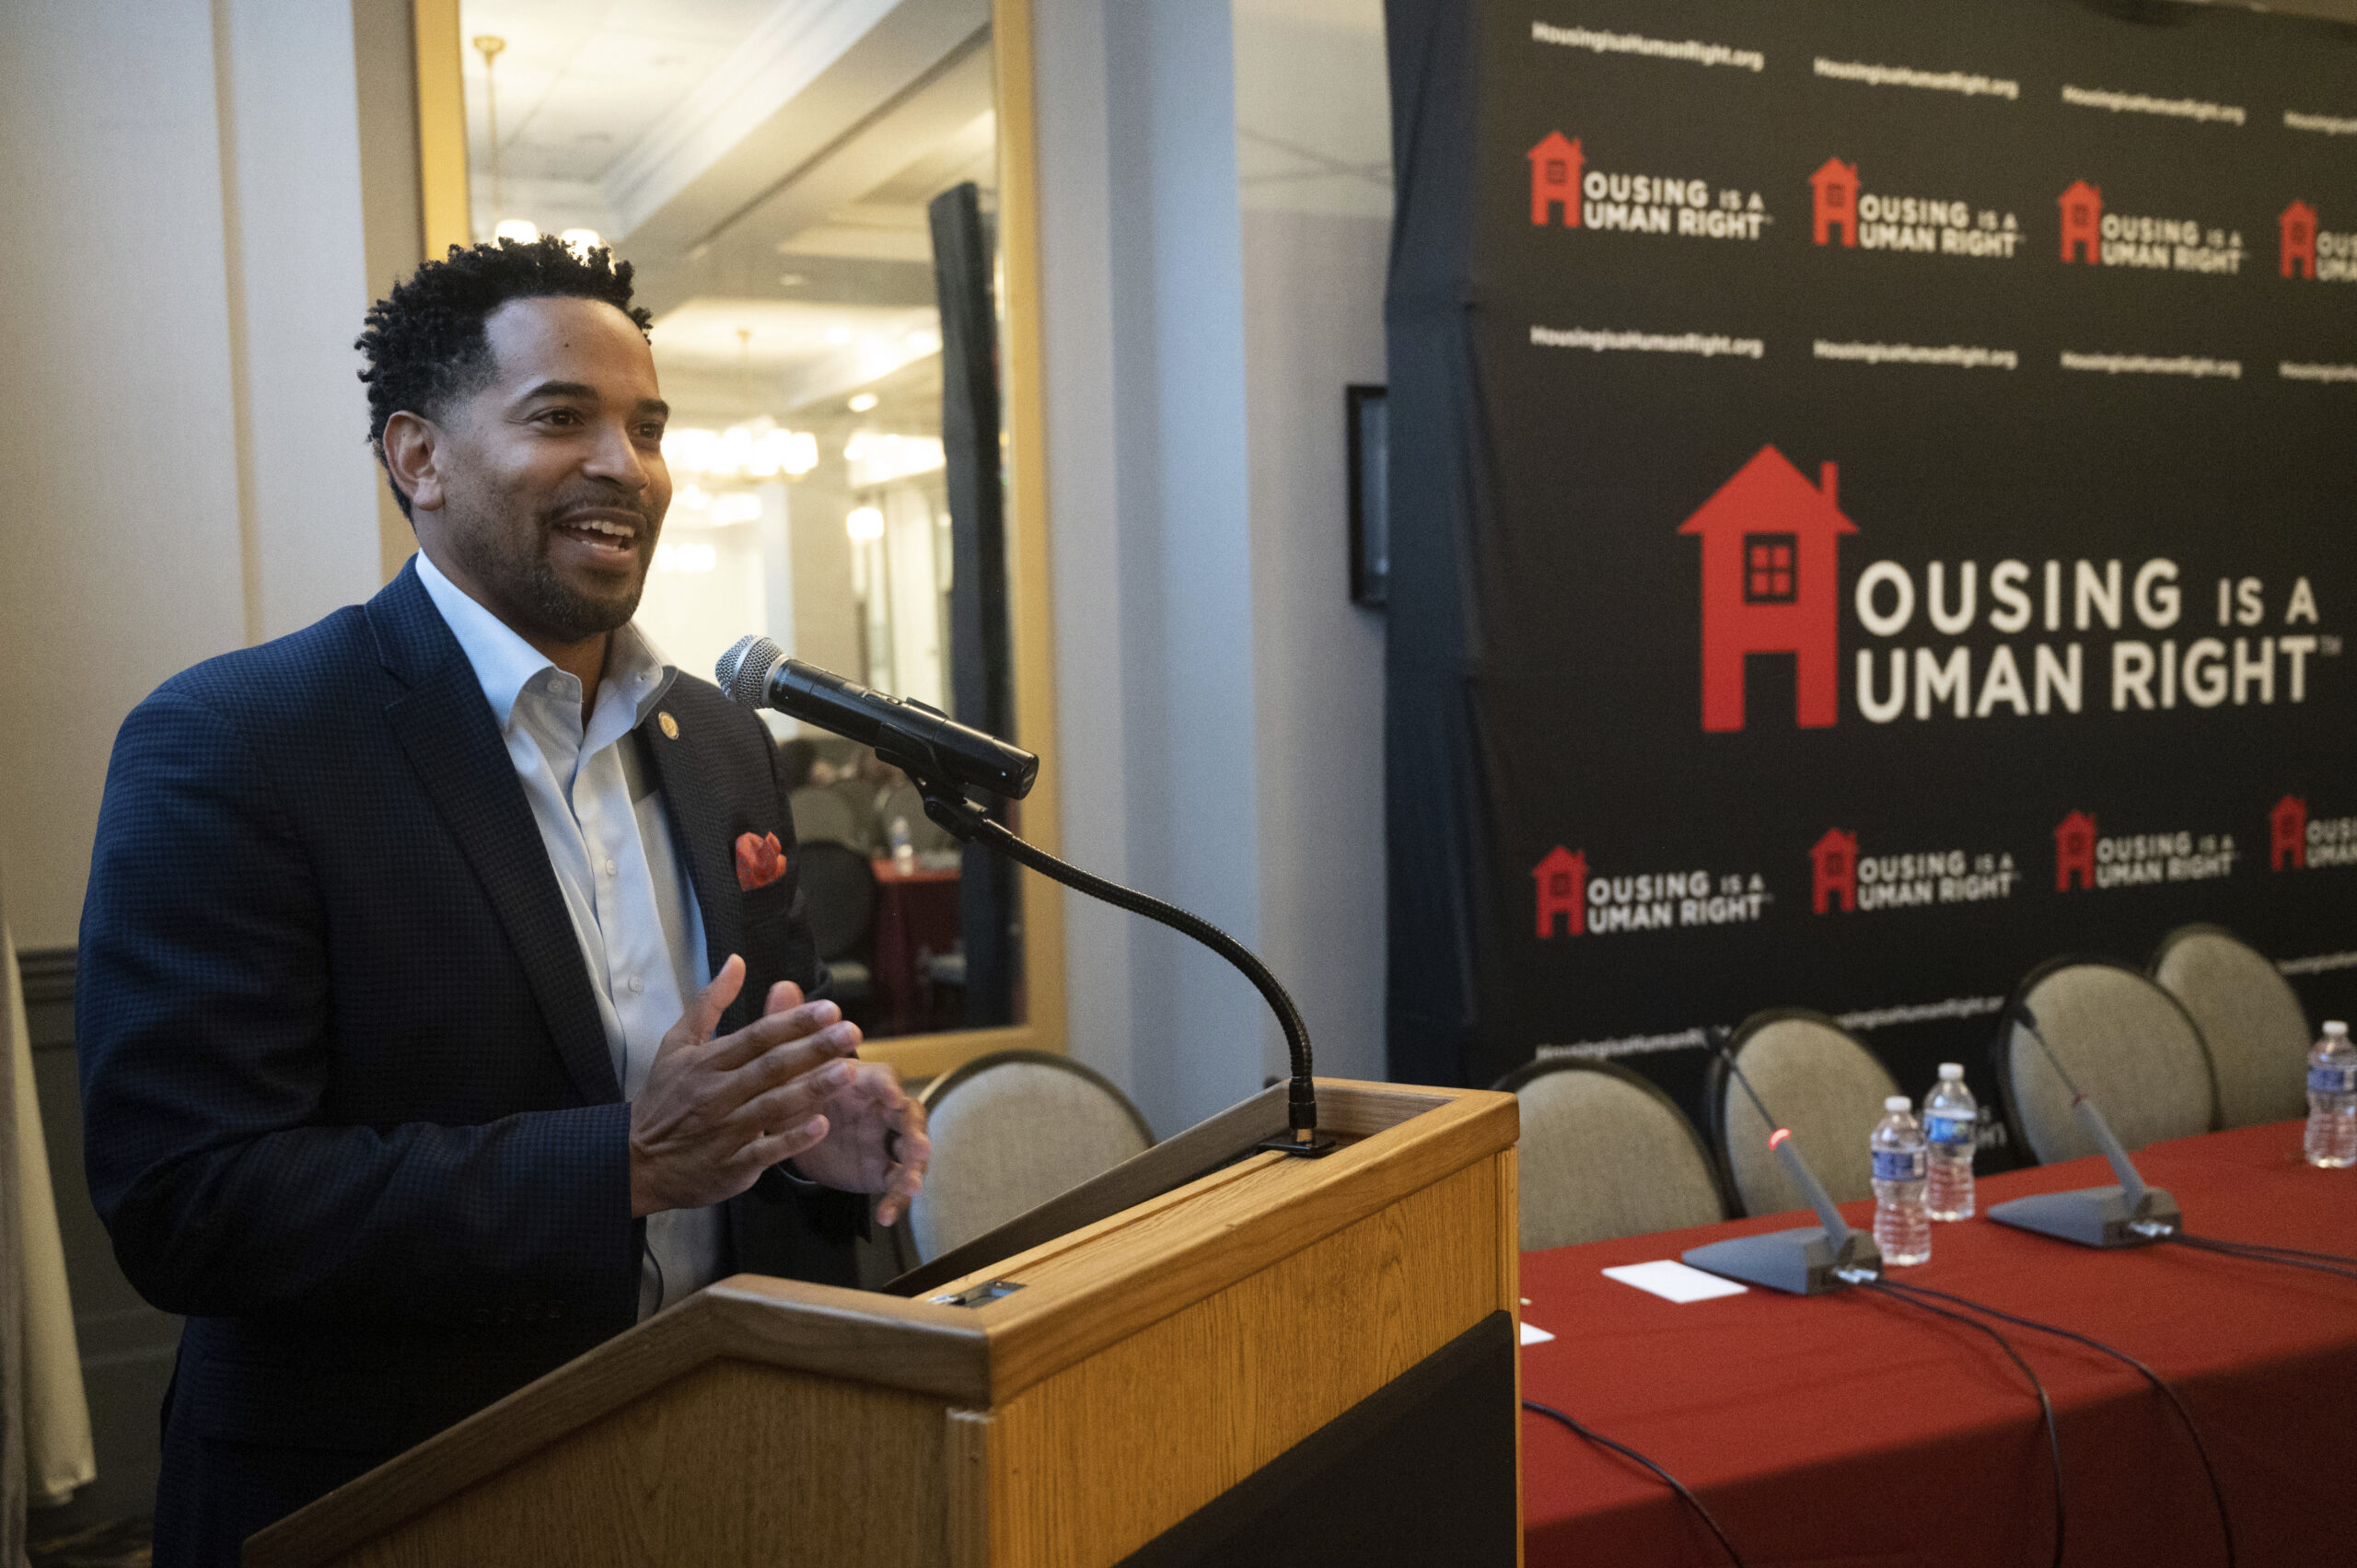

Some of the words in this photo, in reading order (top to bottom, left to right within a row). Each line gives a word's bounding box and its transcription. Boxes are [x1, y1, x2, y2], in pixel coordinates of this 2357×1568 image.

[1719, 190, 1741, 211] IS
[1748, 192, 1765, 212] A
[1678, 208, 1763, 239] RIGHT
[1978, 210, 1998, 231] IS
[2003, 213, 2018, 232] A
[1941, 229, 2014, 258] RIGHT
[1855, 557, 2181, 636] OUSING
[2218, 576, 2265, 627] IS
[2284, 575, 2319, 625] A
[1856, 642, 2083, 724] UMAN
[2112, 635, 2318, 711] RIGHT
[1975, 853, 1995, 872] IS
[1999, 851, 2014, 870] A
[1721, 873, 1742, 895] IS
[1749, 872, 1764, 892] A
[1938, 873, 2011, 903] RIGHT
[1680, 893, 1761, 926] RIGHT
